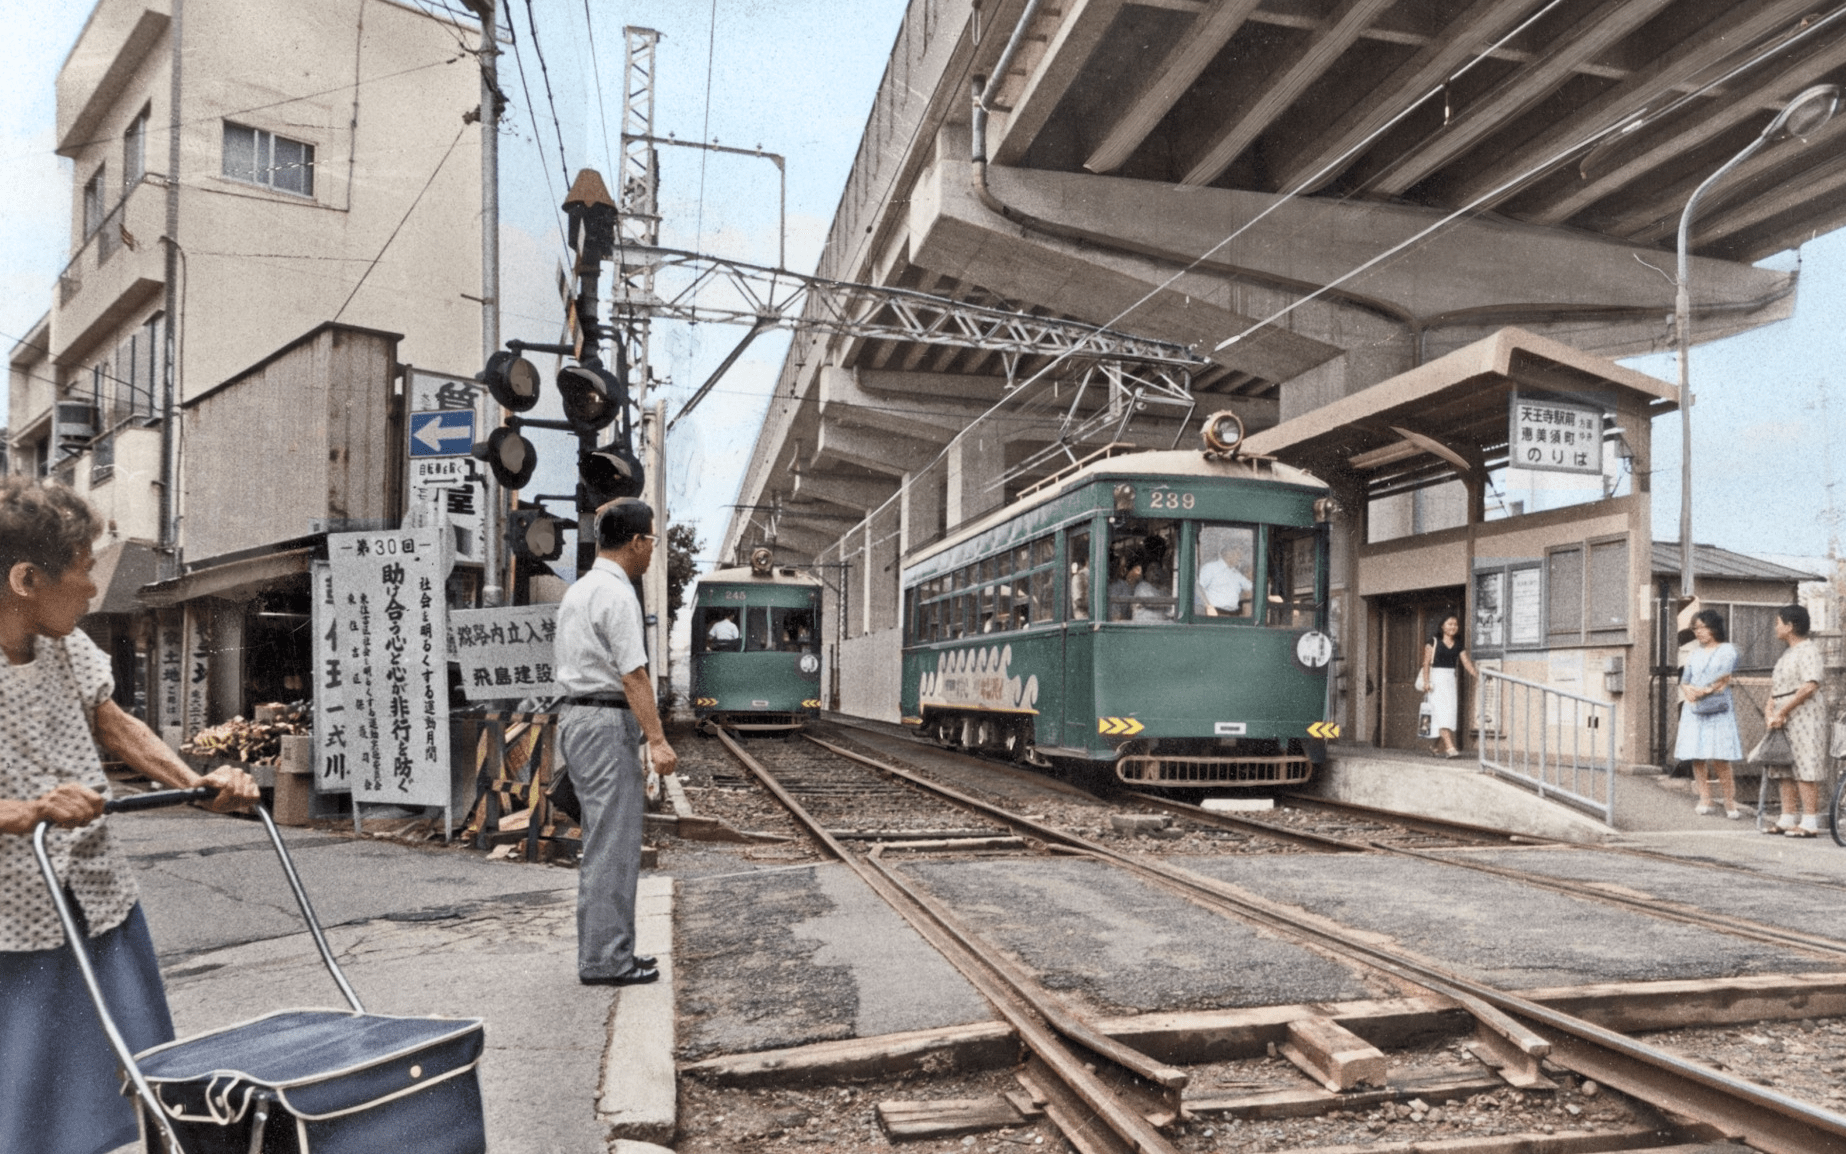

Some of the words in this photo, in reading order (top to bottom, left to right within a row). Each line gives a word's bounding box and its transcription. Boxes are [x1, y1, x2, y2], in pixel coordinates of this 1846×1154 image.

[1521, 406, 1575, 426] 天王寺駅前
[1521, 427, 1575, 446] 恵美須町
[1150, 491, 1195, 509] 239
[382, 562, 414, 793] 助け合う心と心が非行を防ぐ
[473, 663, 555, 687] 飛島建設
